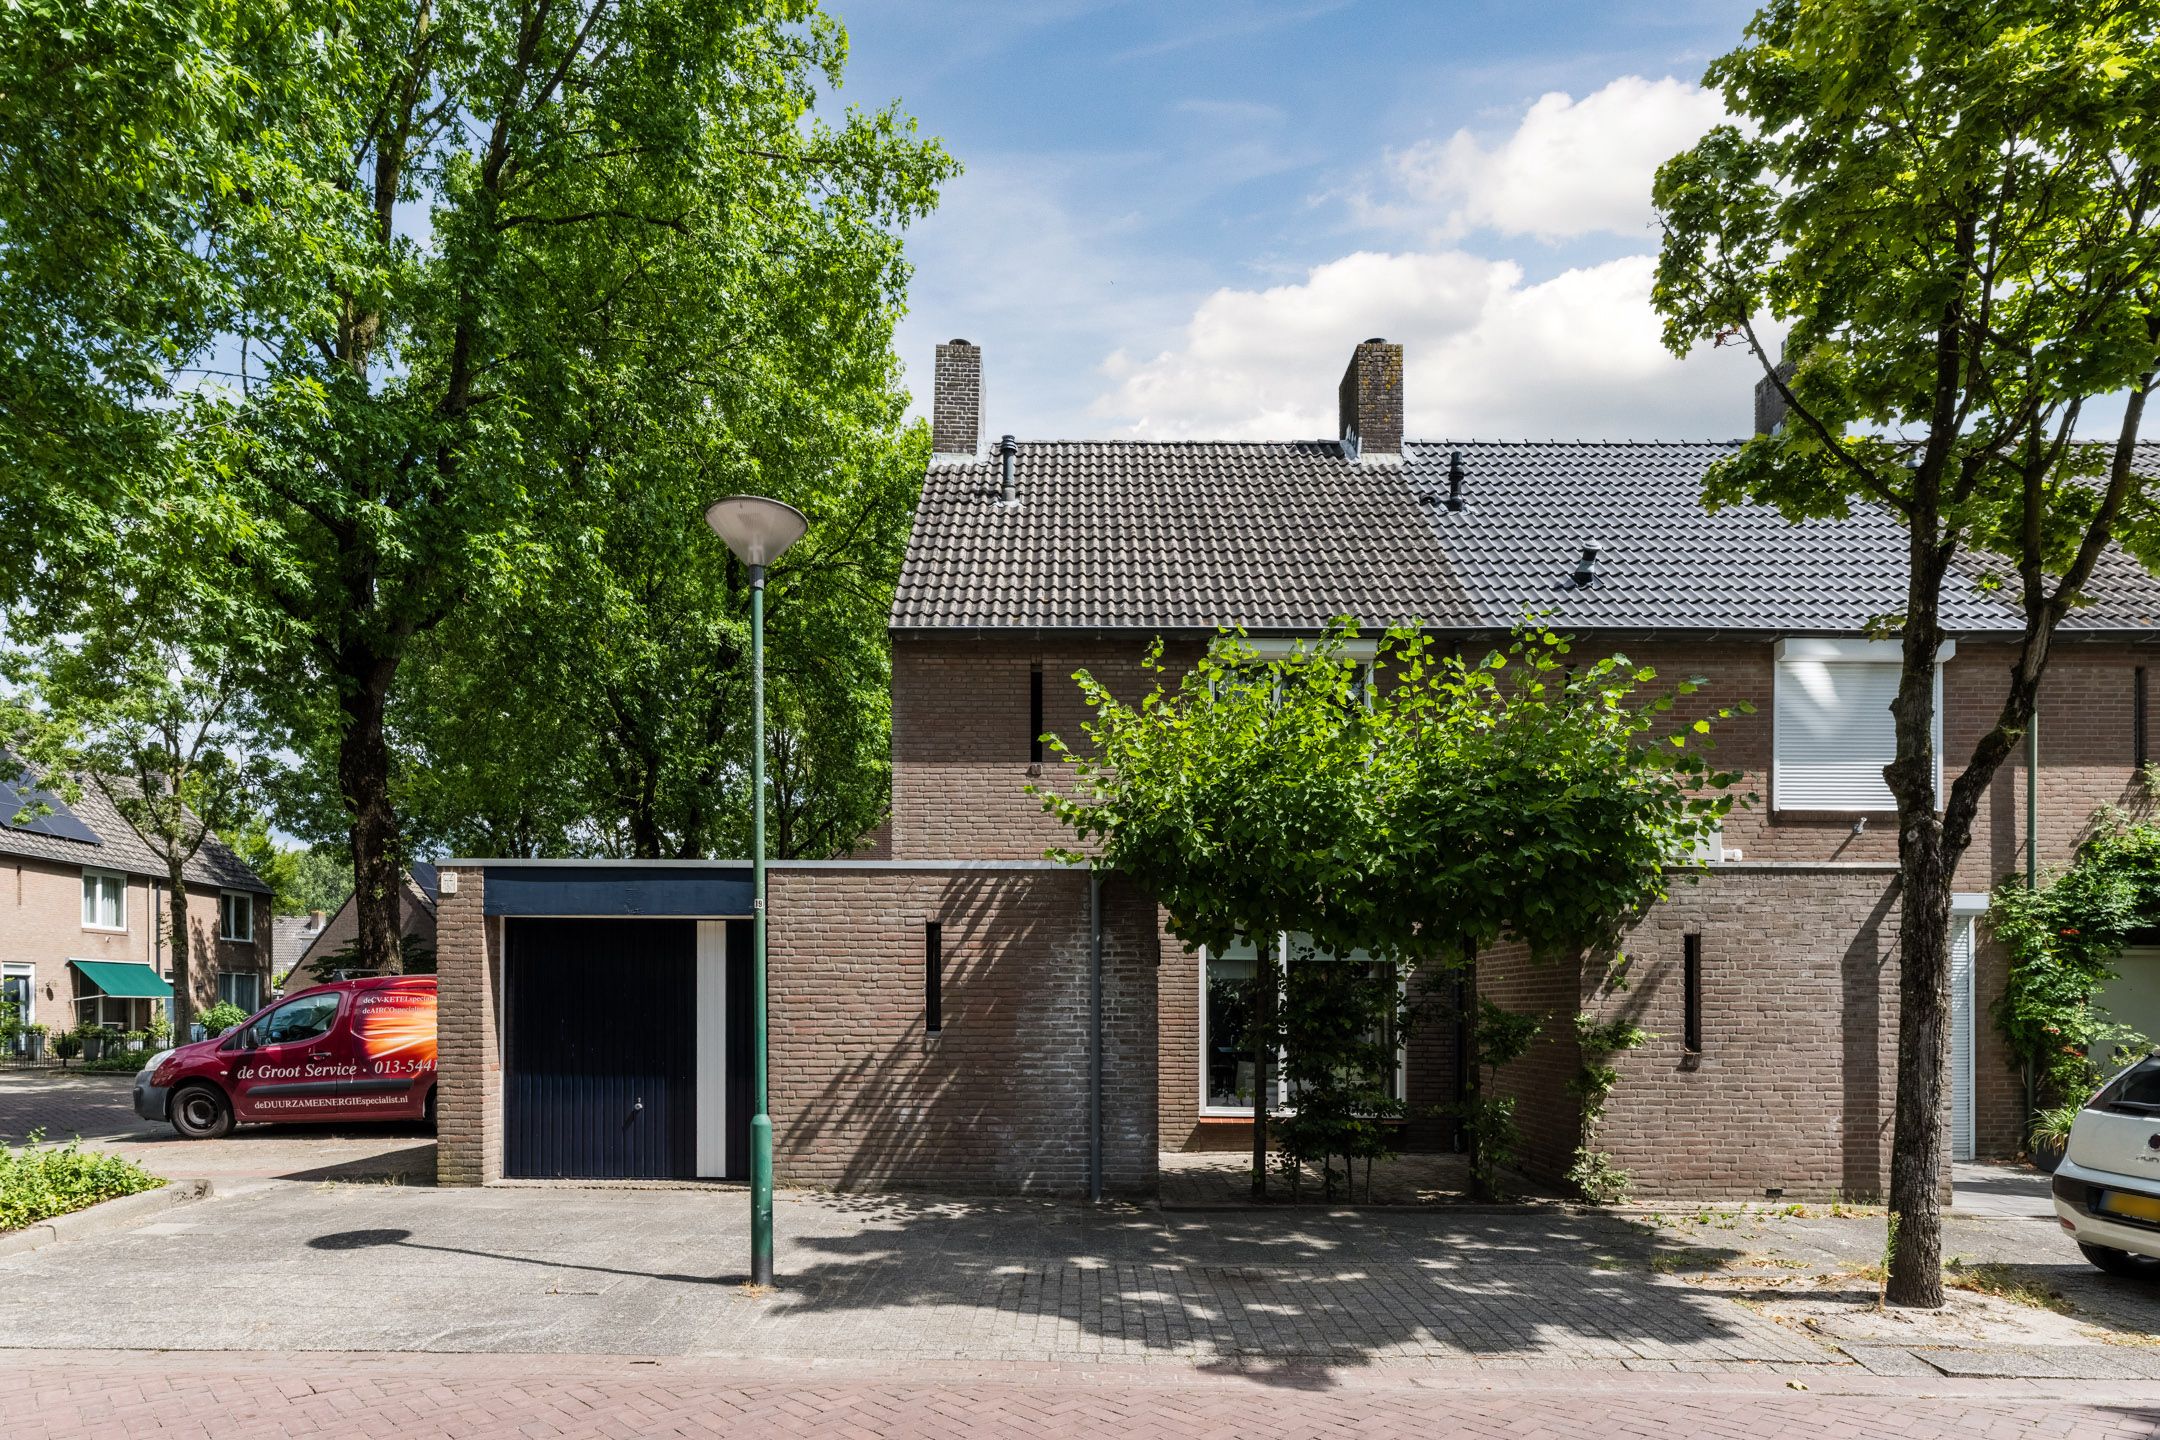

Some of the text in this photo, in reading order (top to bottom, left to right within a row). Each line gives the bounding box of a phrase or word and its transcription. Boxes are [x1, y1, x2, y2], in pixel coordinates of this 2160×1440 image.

[755, 900, 763, 908] 19
[237, 1066, 254, 1079] de
[258, 1065, 300, 1079] Groot
[304, 1063, 357, 1077] Service
[254, 1095, 408, 1110] deDUURZAMEENERGIEspecialist.nl
